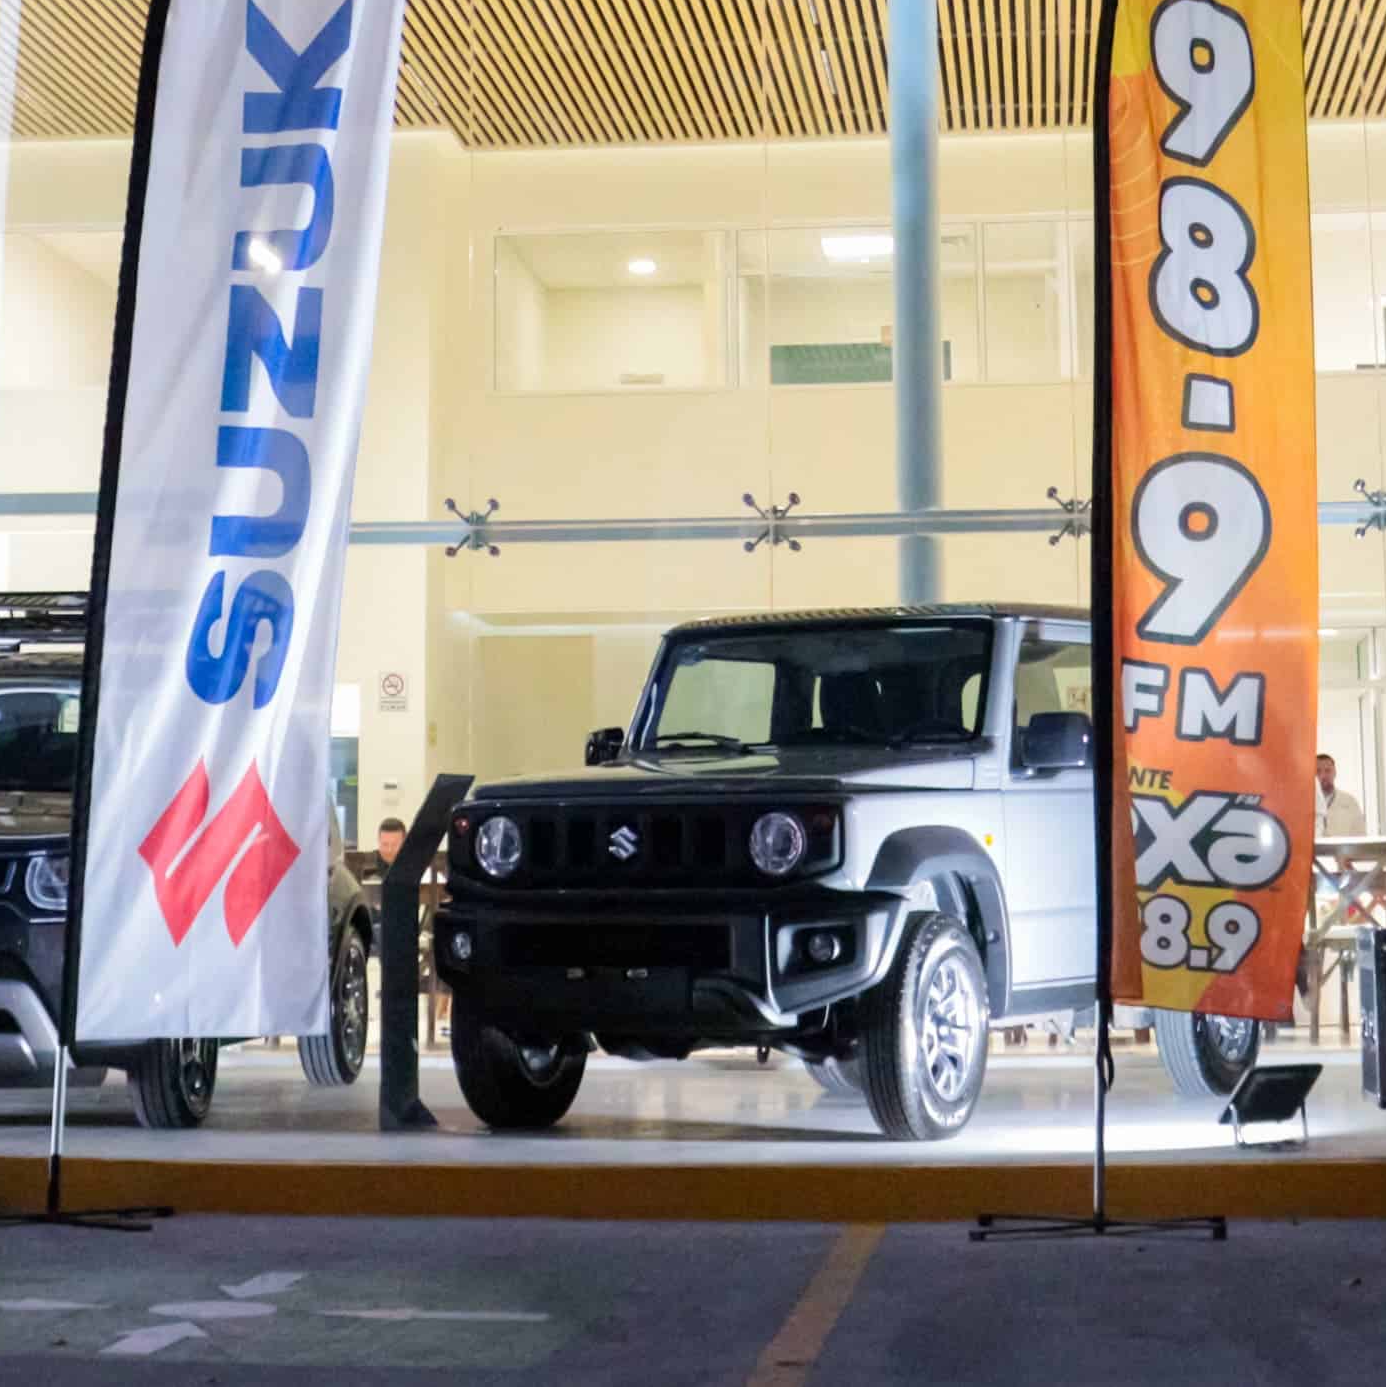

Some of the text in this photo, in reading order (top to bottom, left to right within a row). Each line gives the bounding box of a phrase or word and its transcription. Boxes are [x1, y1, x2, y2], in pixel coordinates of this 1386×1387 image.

[1121, 658, 1266, 747] FM
[1129, 765, 1174, 790] NTE
[1138, 893, 1262, 975] 8.9
